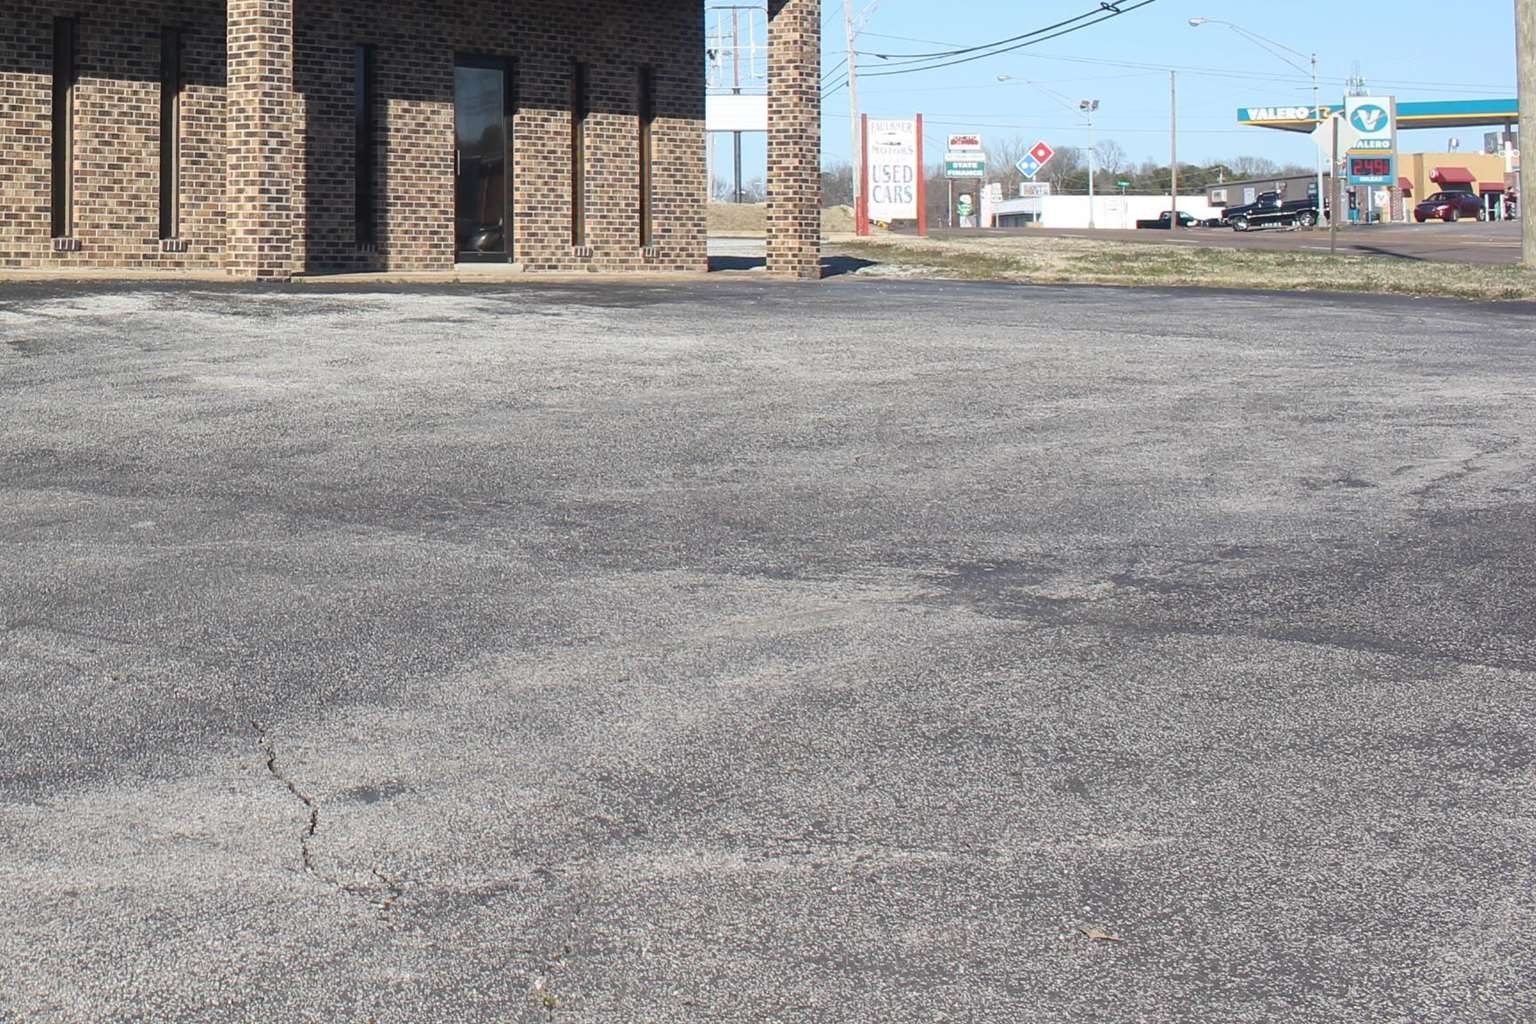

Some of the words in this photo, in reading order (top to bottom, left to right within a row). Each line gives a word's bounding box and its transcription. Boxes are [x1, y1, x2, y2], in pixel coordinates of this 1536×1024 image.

[1247, 107, 1310, 120] VALERO
[872, 164, 913, 183] USED
[872, 185, 913, 204] CARS
